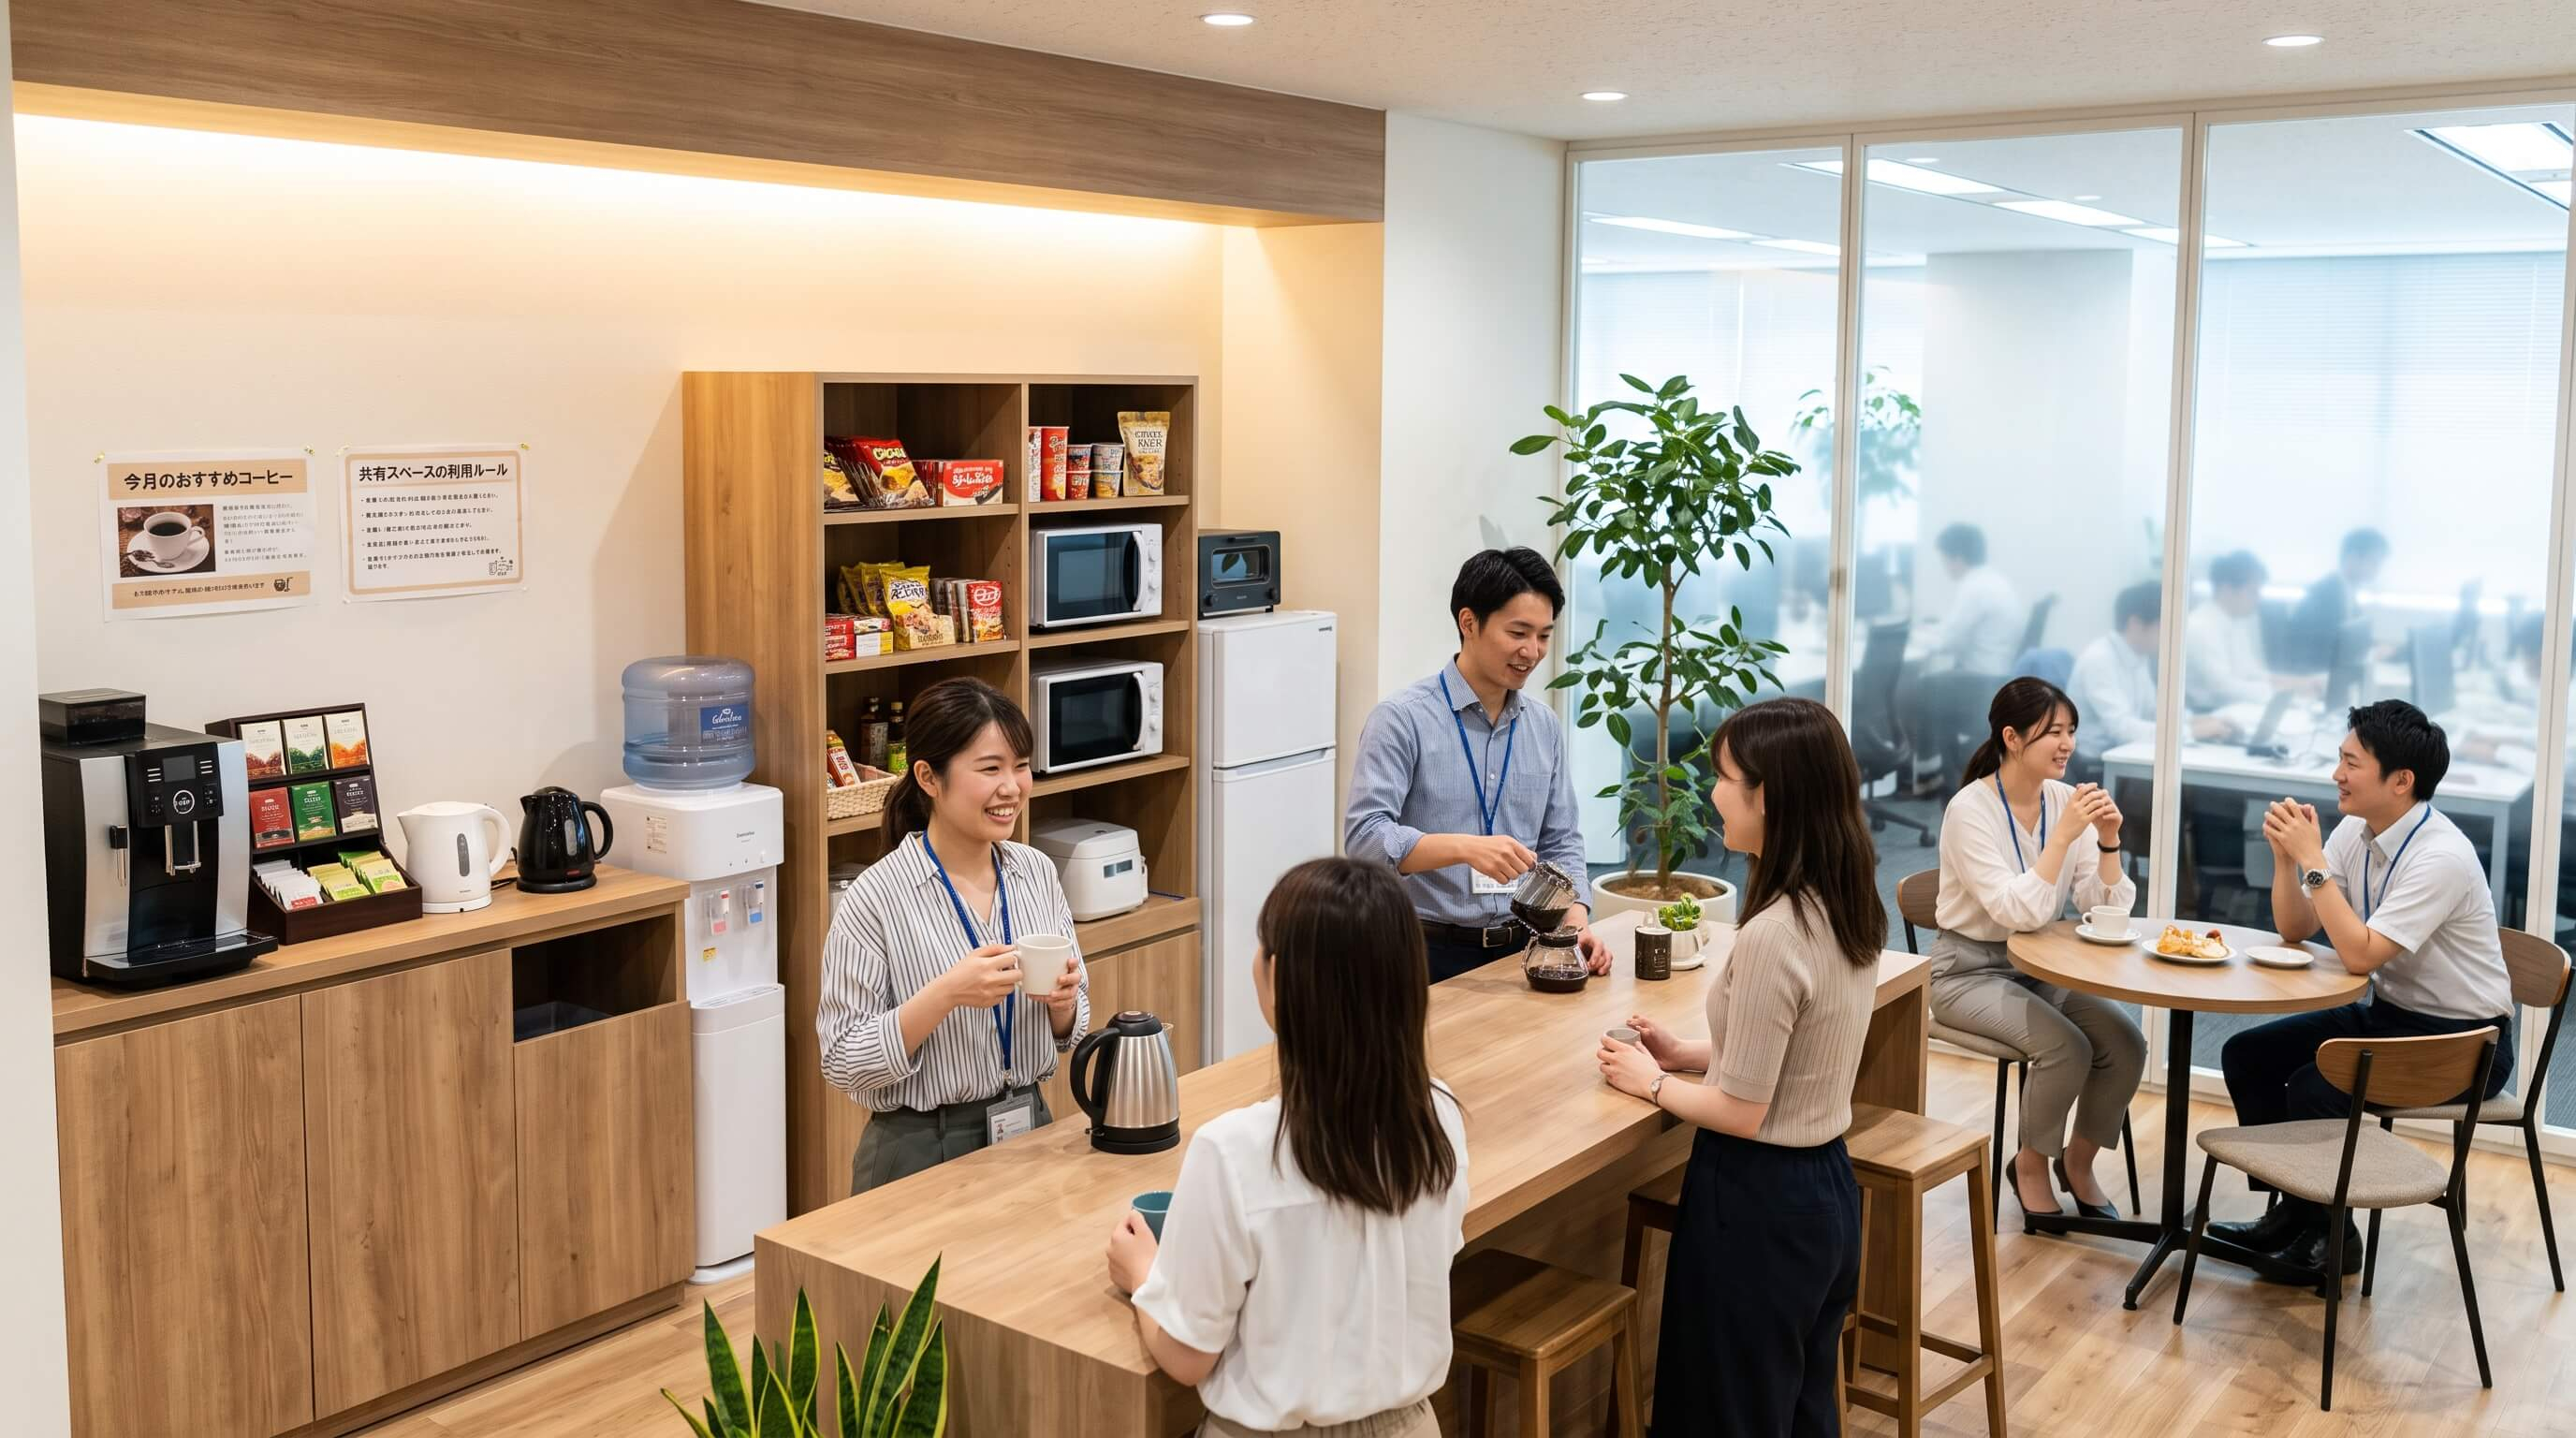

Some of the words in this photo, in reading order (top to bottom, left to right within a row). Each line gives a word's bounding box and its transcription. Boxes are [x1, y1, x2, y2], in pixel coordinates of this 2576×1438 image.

[124, 469, 293, 491] 今月のおすすめコーヒー
[359, 462, 508, 482] 共有スペースの利用ルール
